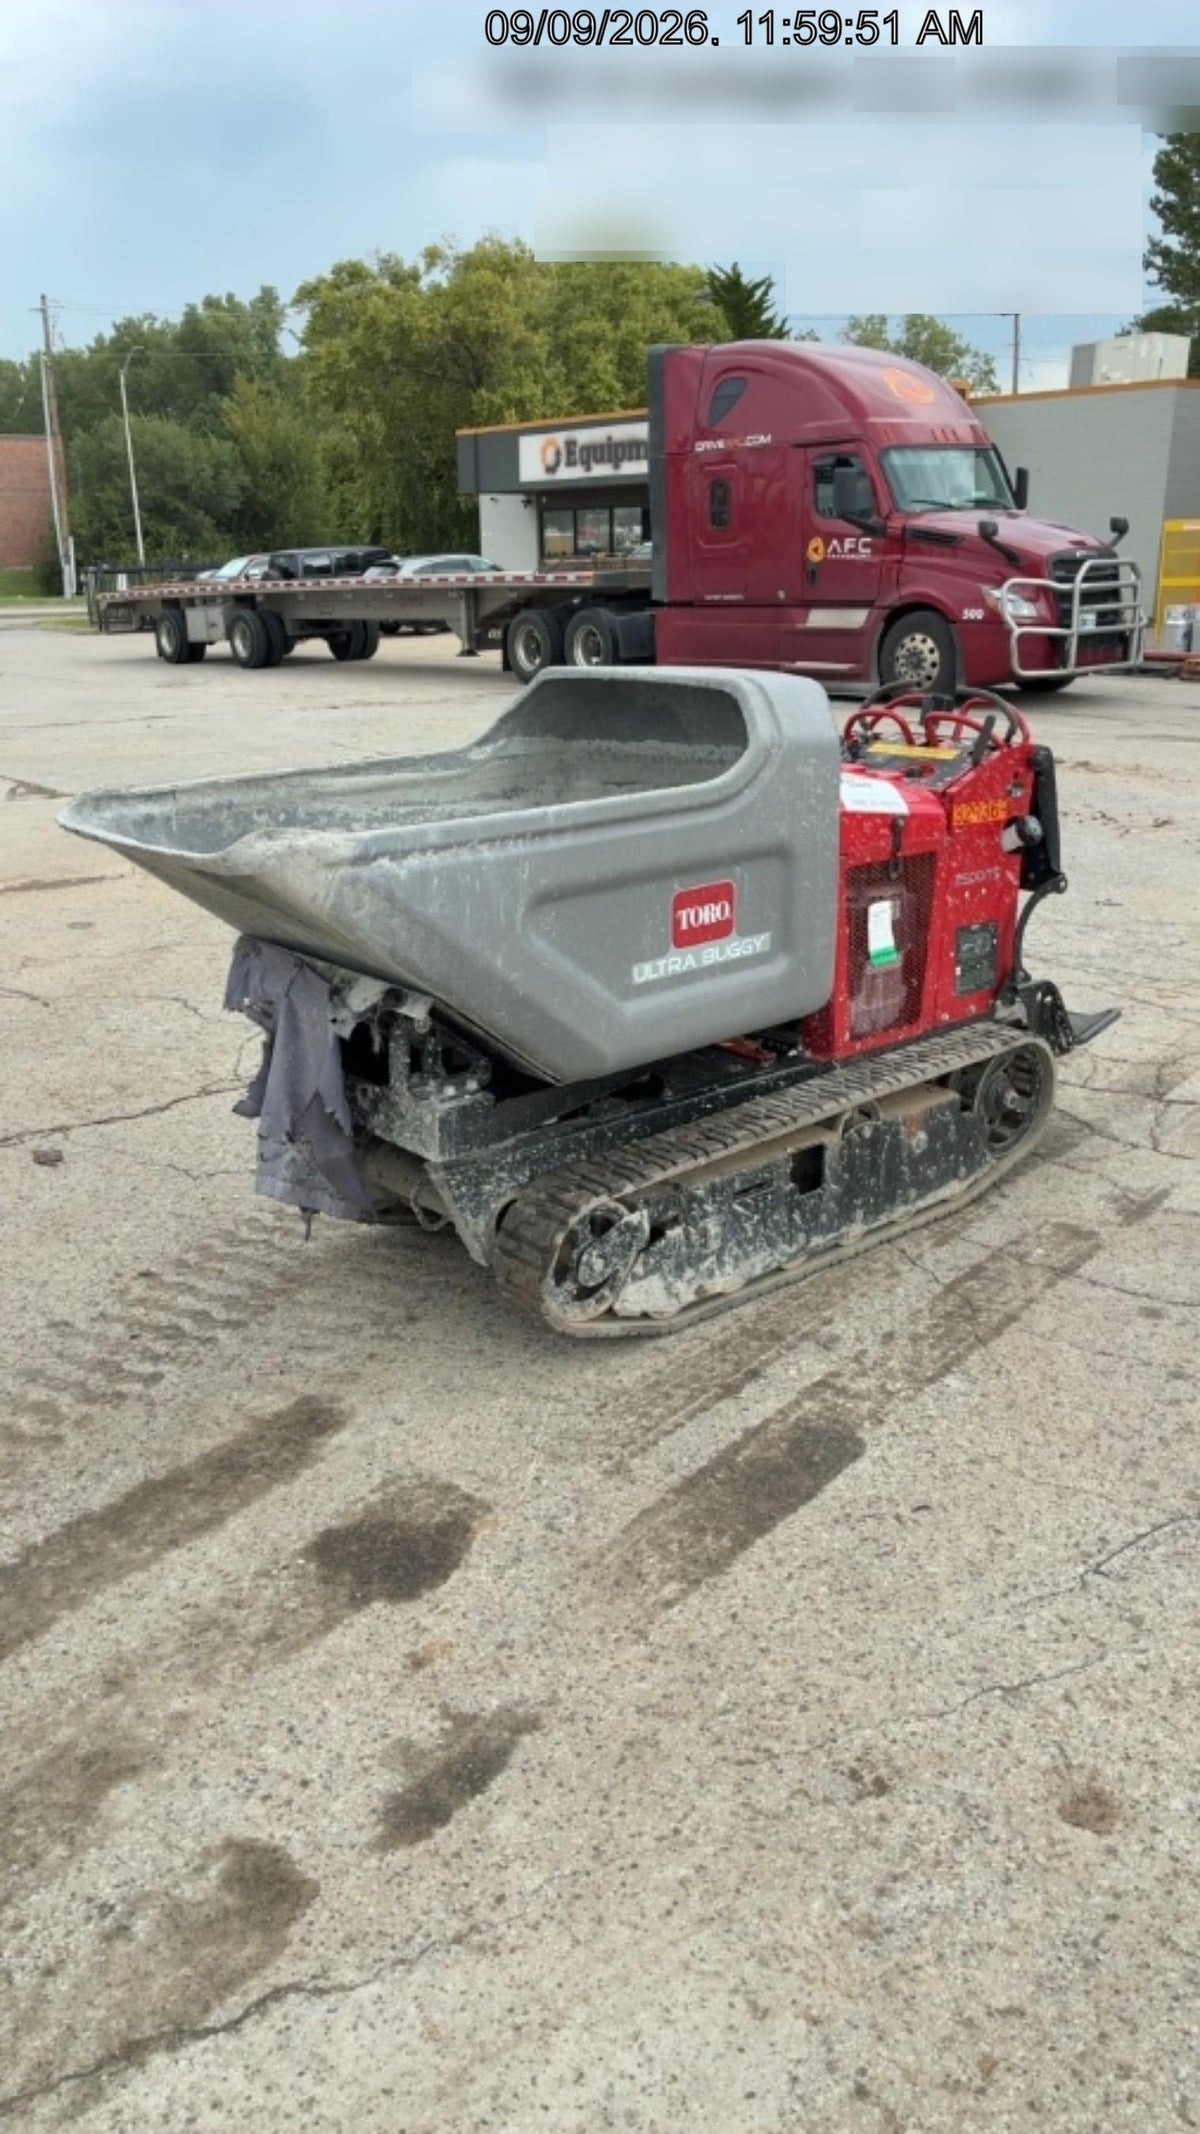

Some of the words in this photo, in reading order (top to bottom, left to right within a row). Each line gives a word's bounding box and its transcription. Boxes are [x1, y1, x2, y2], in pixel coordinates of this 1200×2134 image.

[827, 537, 872, 554] AFC
[676, 900, 731, 930] TORO
[632, 952, 697, 984] ULTRA
[701, 935, 766, 967] BUGGY
